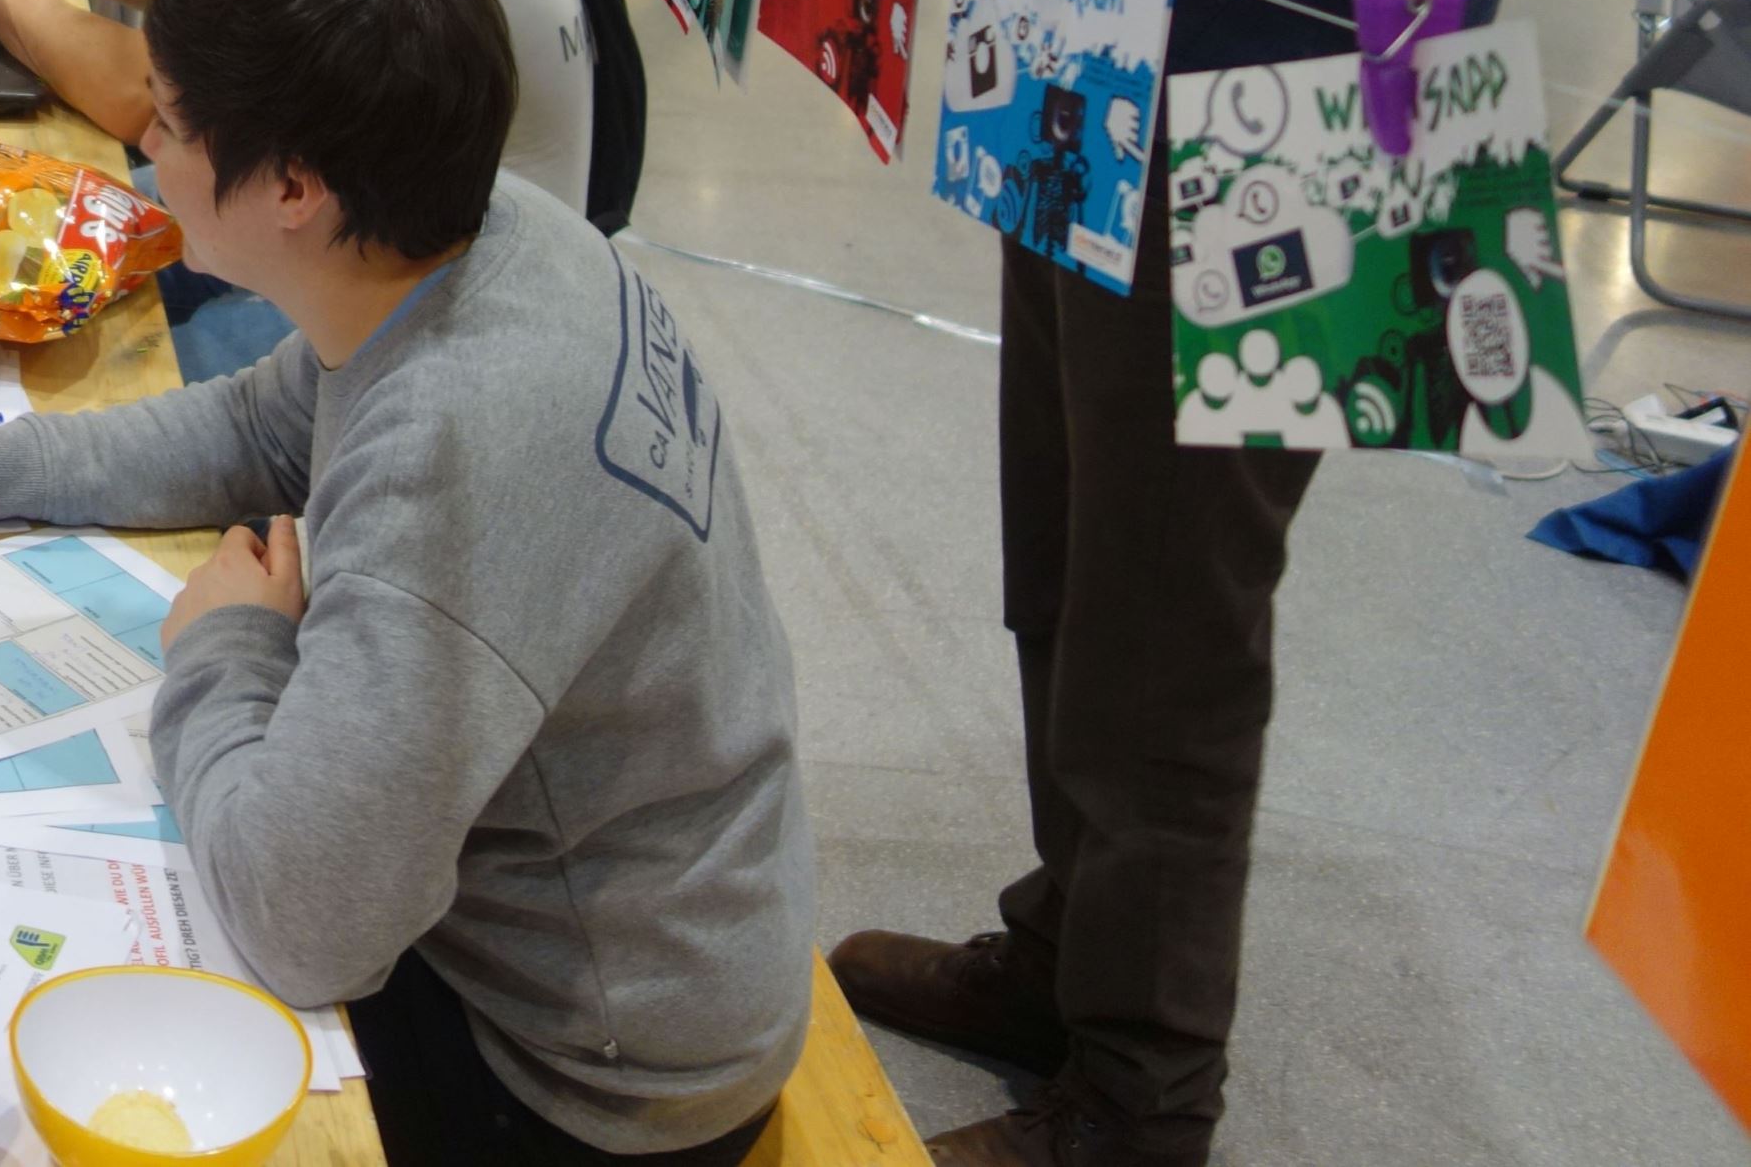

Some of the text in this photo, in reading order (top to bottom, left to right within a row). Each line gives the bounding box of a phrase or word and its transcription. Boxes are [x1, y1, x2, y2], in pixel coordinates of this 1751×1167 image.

[6, 854, 23, 876] ÜBER
[110, 871, 125, 887] DU
[136, 884, 163, 940] AUSFÜLLEN
[168, 883, 189, 919] DIESEN
[176, 919, 197, 947] DREH
[152, 943, 170, 967] OFIL
[185, 947, 203, 969] TIG?
